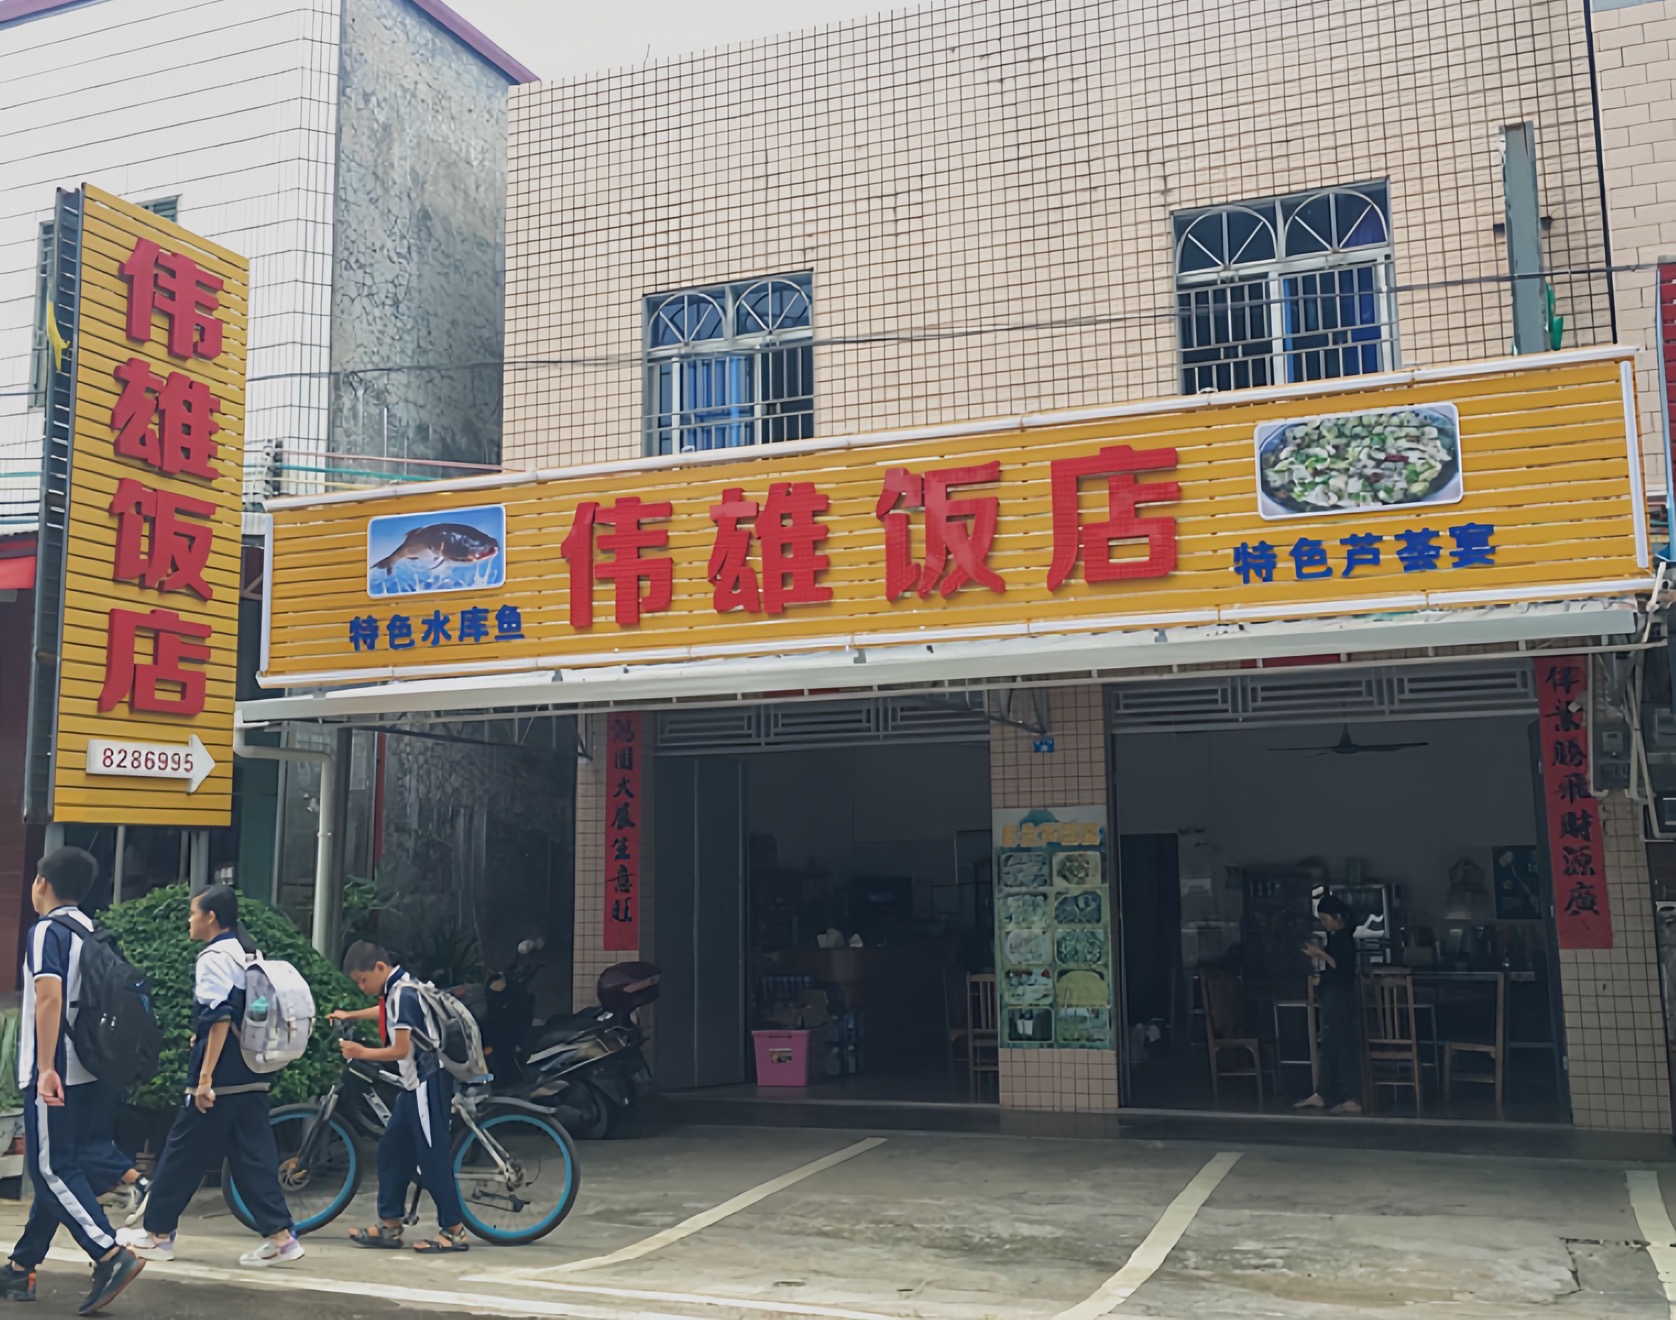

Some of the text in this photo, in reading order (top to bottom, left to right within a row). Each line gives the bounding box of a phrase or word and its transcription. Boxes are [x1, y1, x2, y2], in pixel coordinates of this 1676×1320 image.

[97, 236, 225, 718] 伟雄饭店
[561, 443, 1181, 630] 伟雄饭店
[349, 603, 526, 652] 特色水库鱼
[102, 747, 194, 773] 8286995
